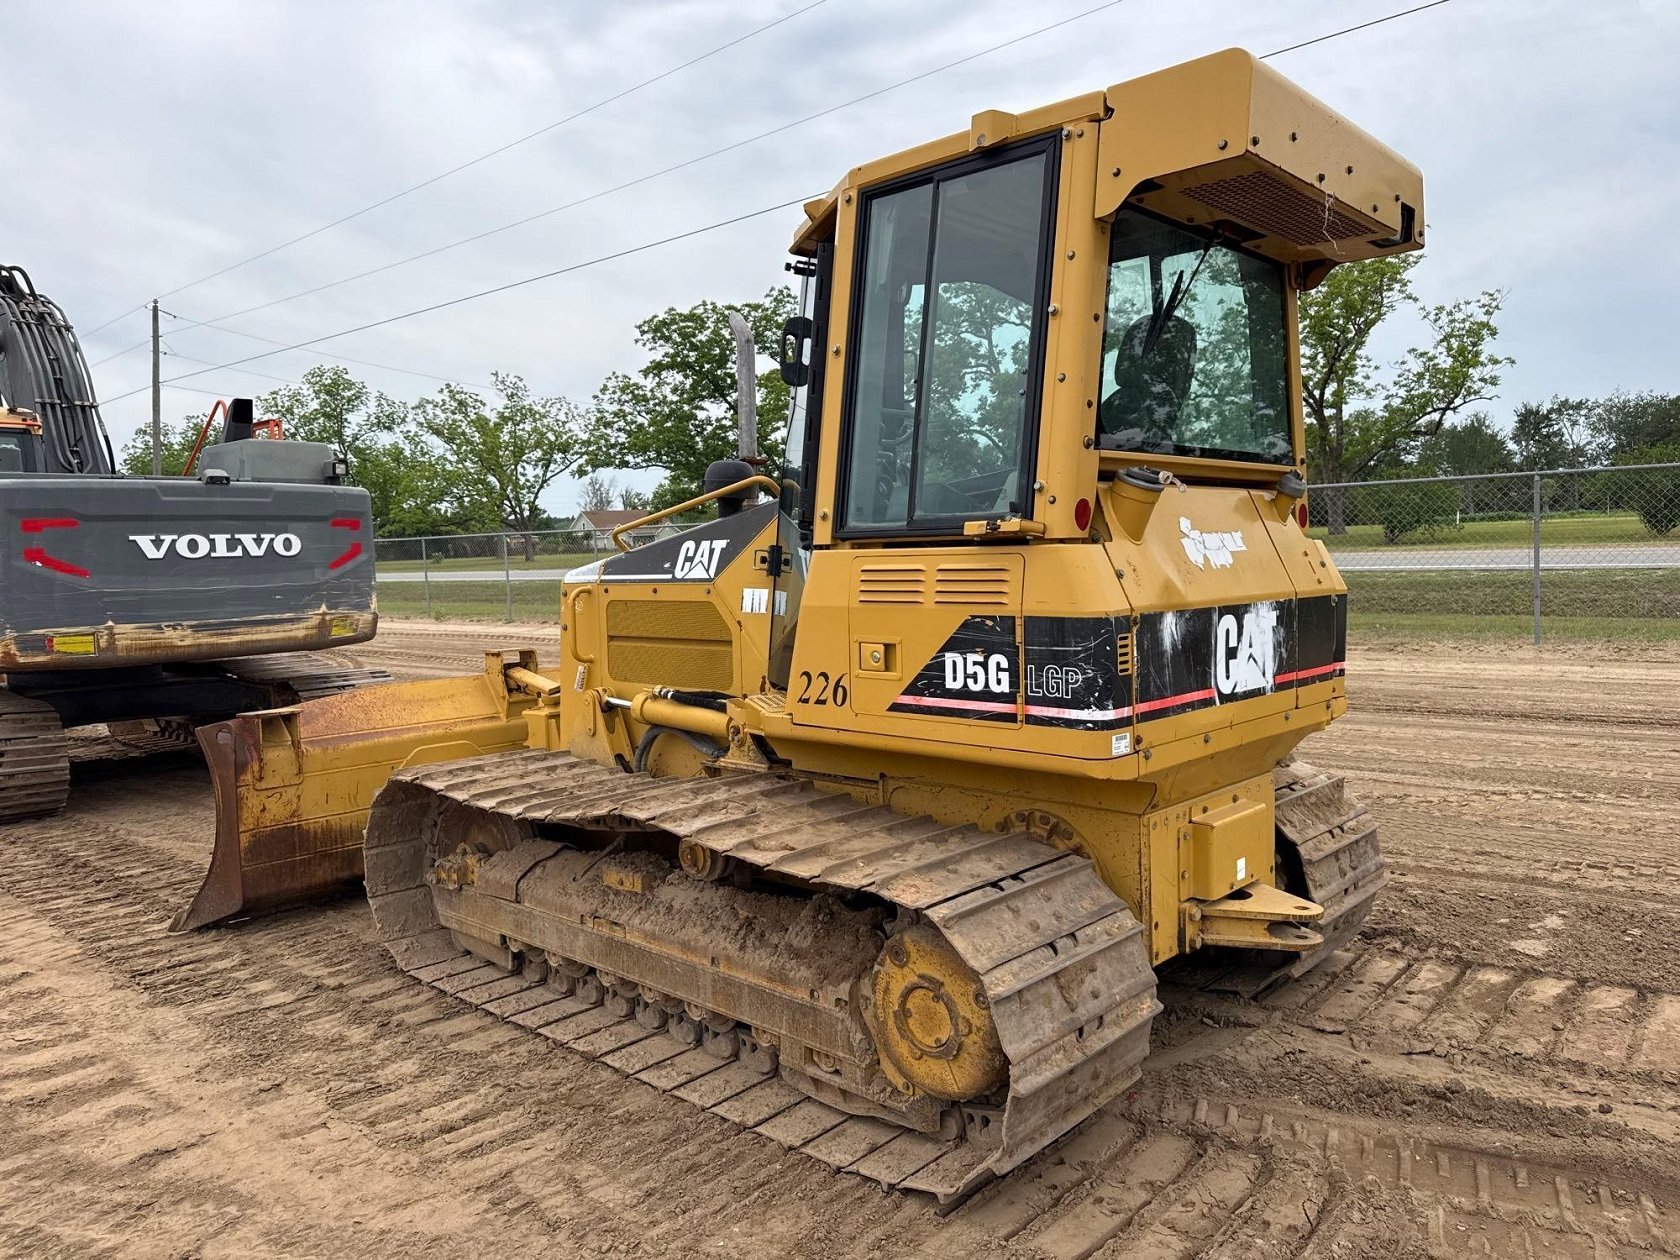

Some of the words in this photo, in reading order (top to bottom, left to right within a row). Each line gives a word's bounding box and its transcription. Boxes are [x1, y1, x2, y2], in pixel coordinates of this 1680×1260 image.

[128, 533, 302, 559] VOLVO
[674, 539, 730, 579] CAT
[1216, 610, 1278, 694] CAT
[796, 670, 849, 707] 226
[944, 652, 1010, 693] D5G
[1027, 664, 1082, 698] LGP
